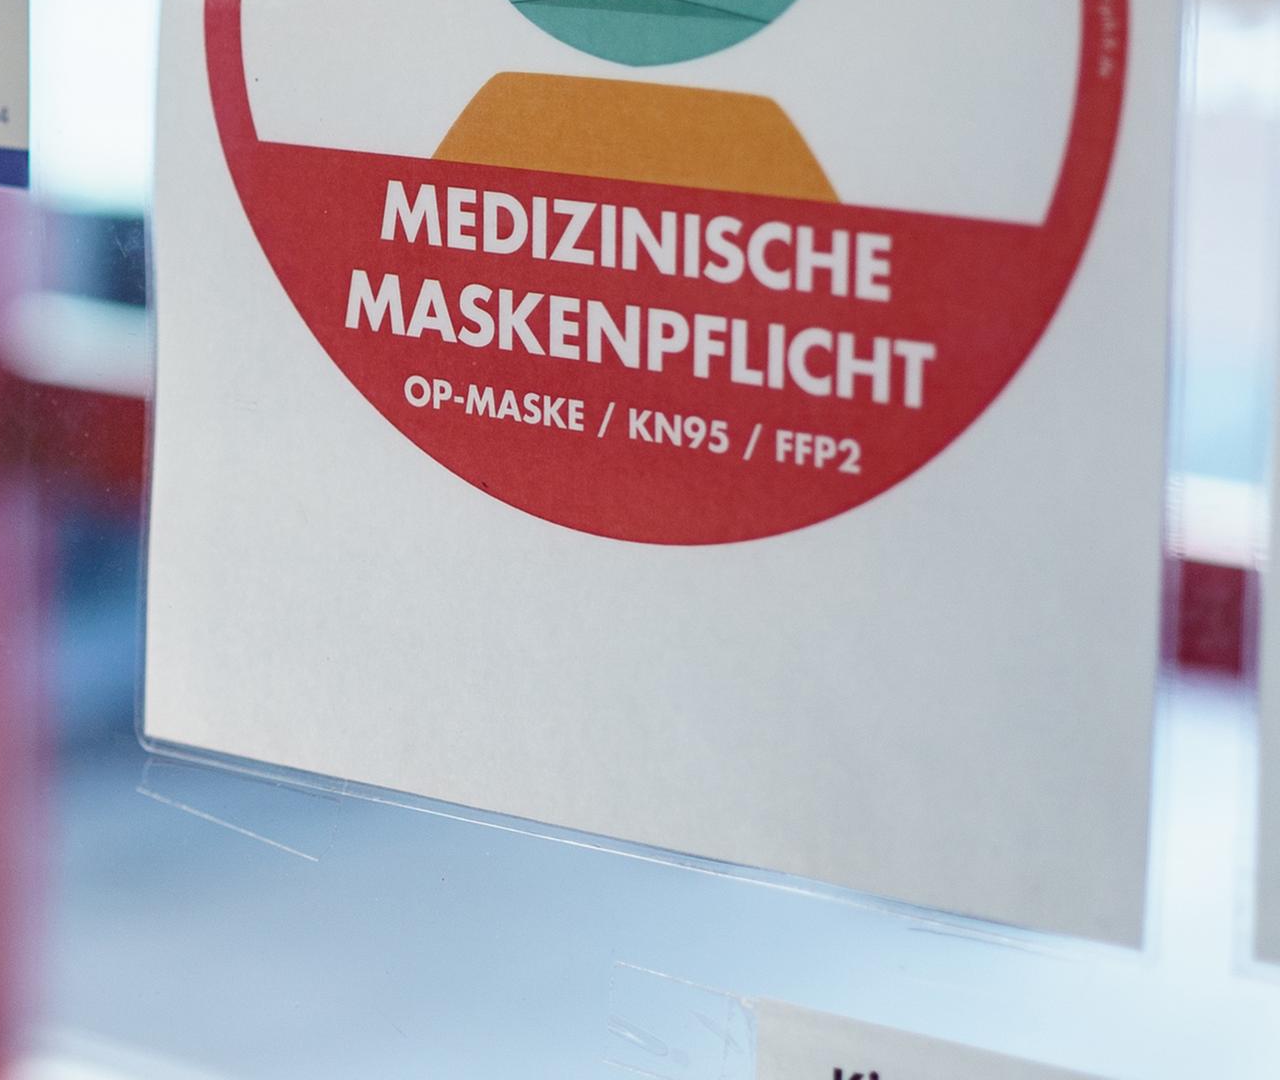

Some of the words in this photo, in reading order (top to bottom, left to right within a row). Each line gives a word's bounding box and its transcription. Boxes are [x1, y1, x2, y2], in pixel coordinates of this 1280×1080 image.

[380, 179, 892, 302] MEDIZINISCHE
[344, 269, 936, 409] MASKENPFLICHT
[403, 375, 585, 432] OP-MASKE
[597, 401, 616, 438] /
[628, 407, 730, 454] KN95
[743, 423, 762, 461] /
[775, 429, 861, 474] FFP2
